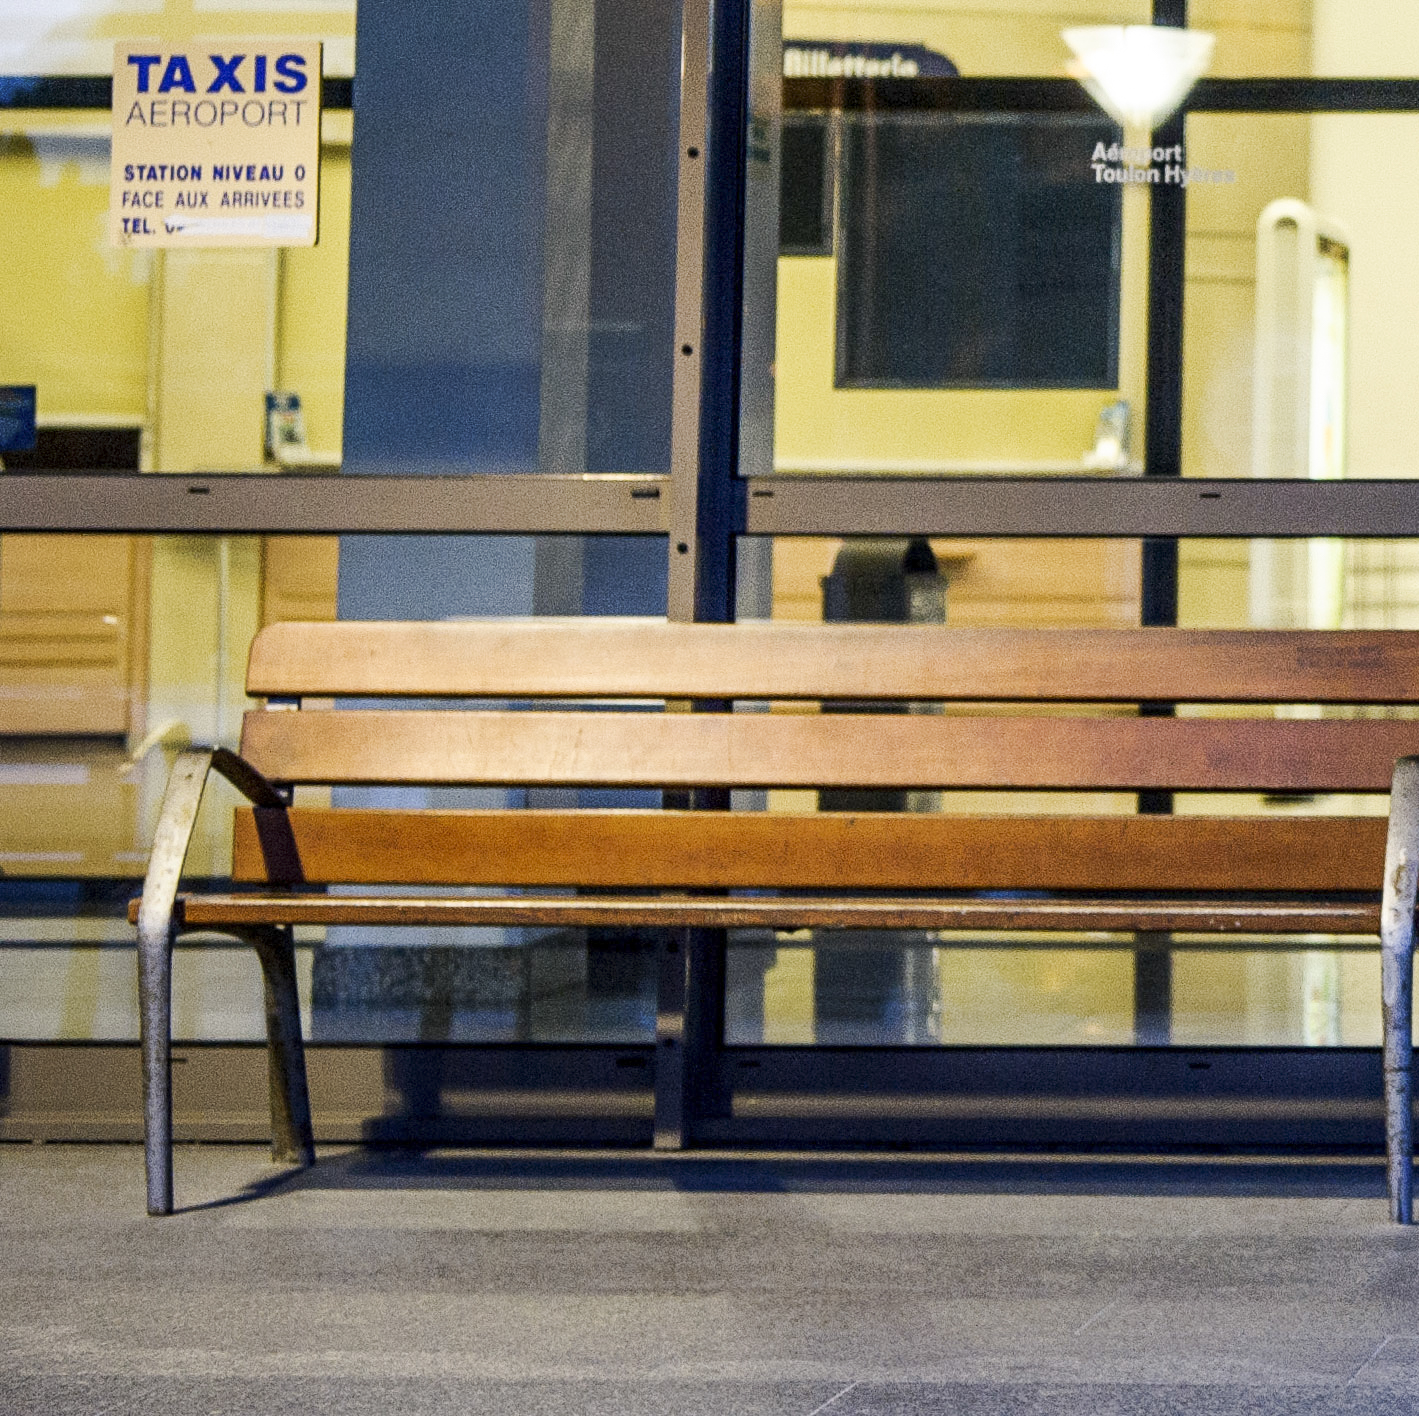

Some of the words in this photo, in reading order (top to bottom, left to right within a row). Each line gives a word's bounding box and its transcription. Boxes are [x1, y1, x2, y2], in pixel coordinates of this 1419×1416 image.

[127, 53, 308, 94] TAXIS
[126, 99, 307, 127] AEROPORT
[1091, 141, 1182, 164] Aéroport
[123, 164, 202, 182] STATION
[212, 164, 284, 182] NIVEAU
[1091, 163, 1160, 183] Toulon
[122, 190, 164, 208] FACE
[175, 190, 209, 208] AUX
[220, 190, 304, 208] ARRIVEES
[121, 217, 156, 234] TEL.
